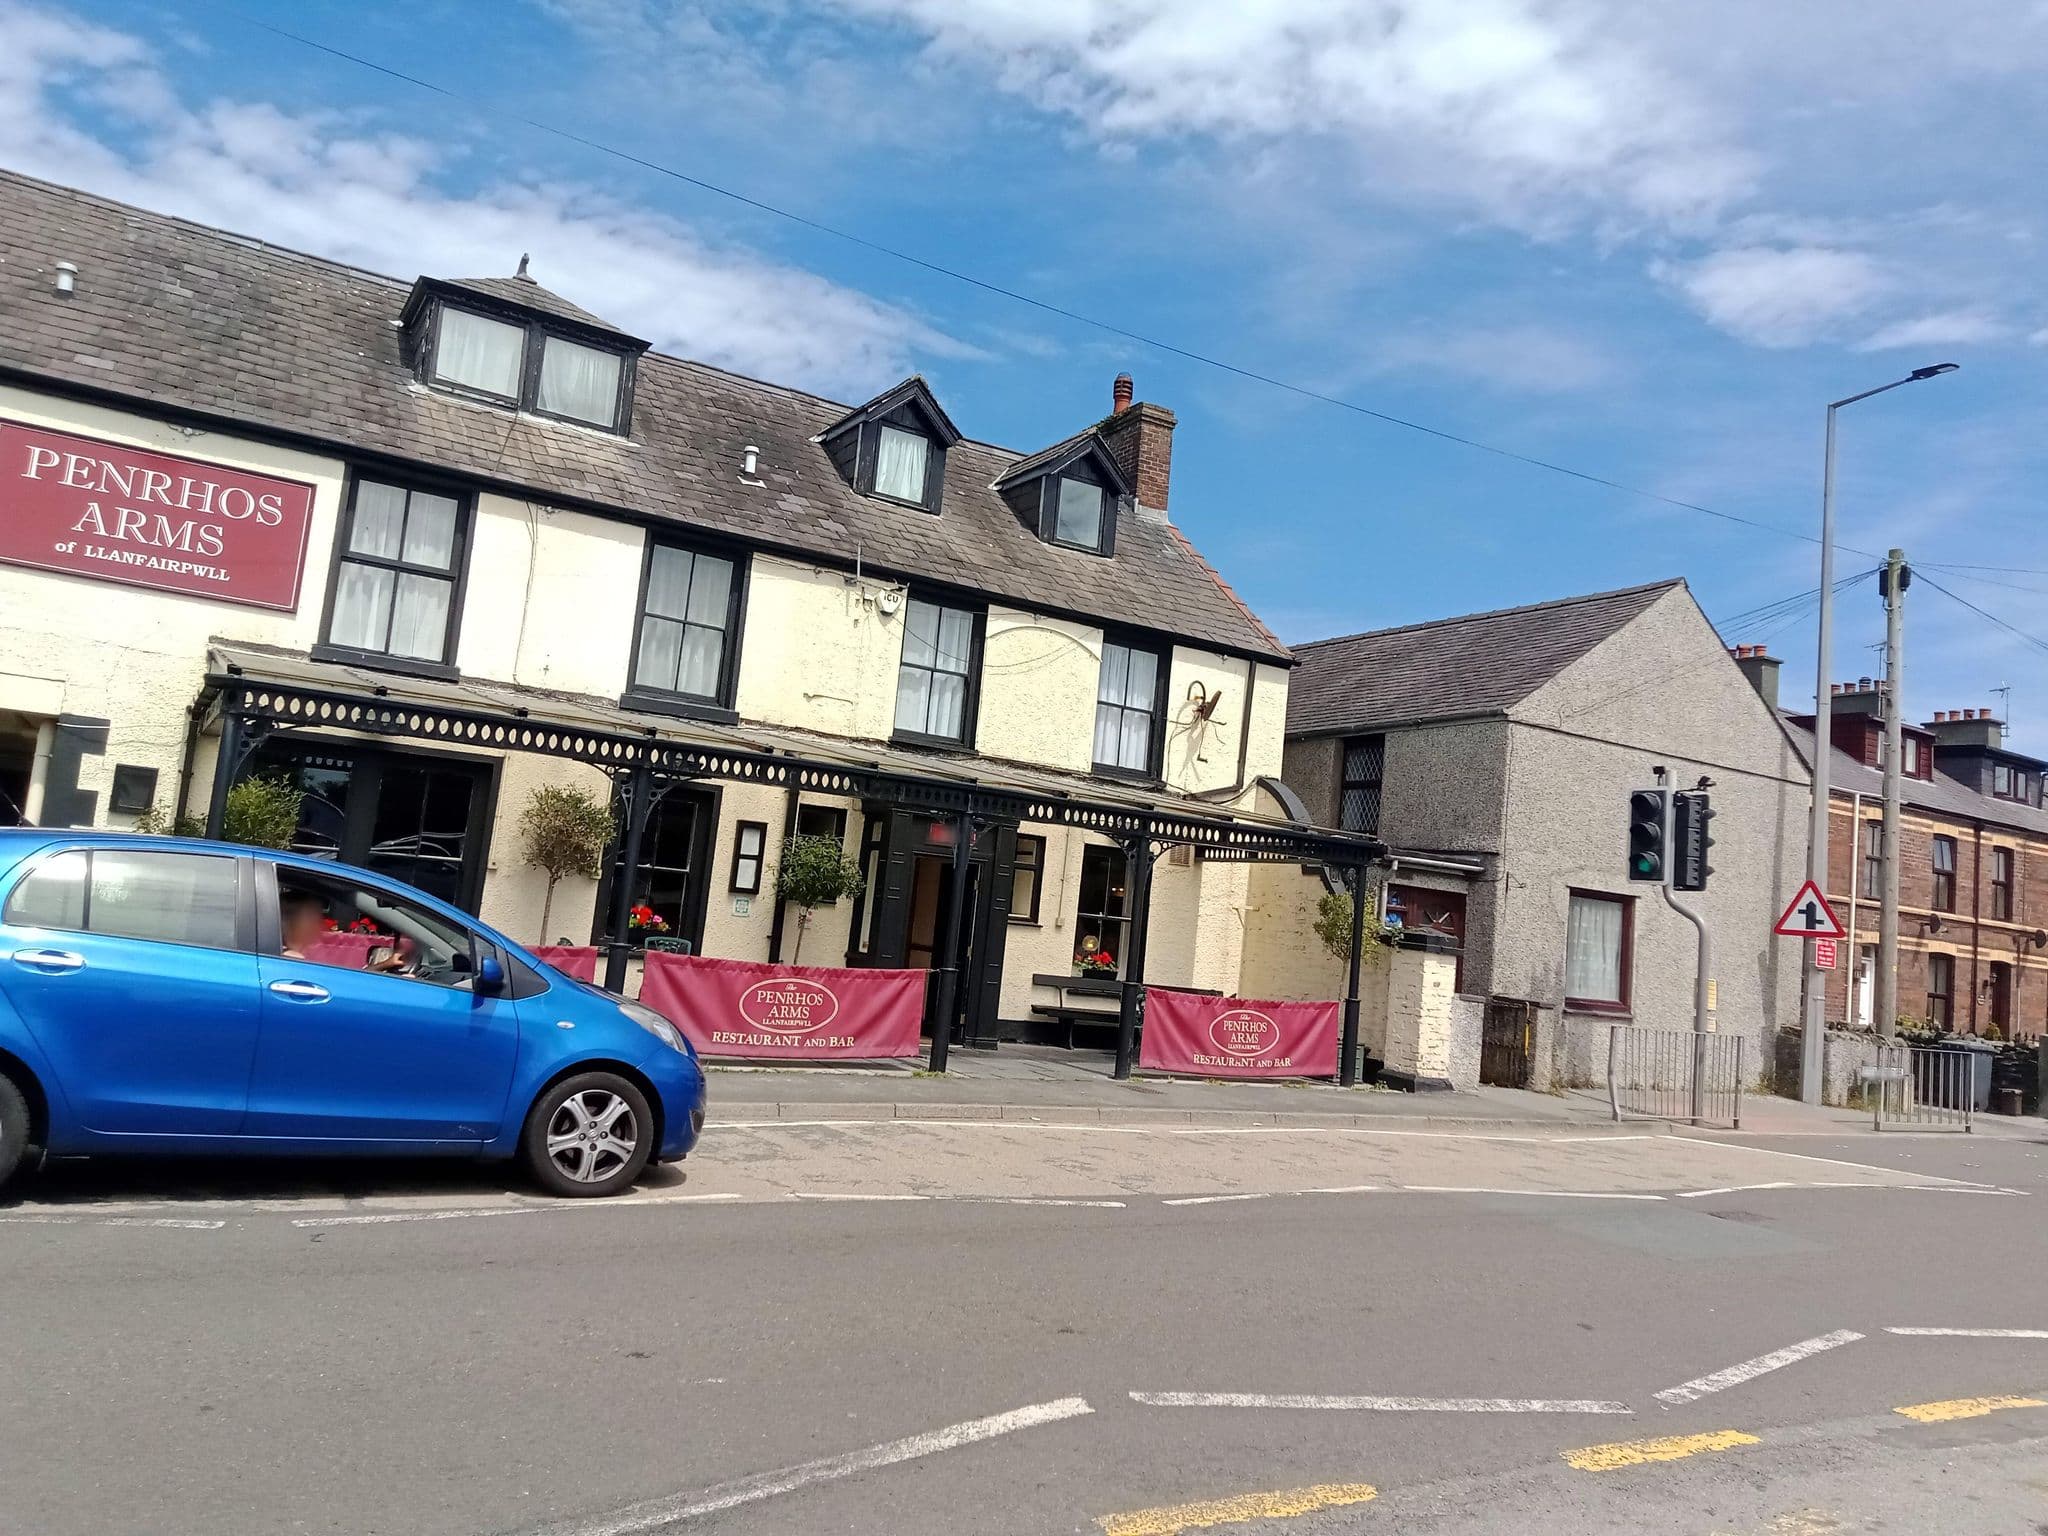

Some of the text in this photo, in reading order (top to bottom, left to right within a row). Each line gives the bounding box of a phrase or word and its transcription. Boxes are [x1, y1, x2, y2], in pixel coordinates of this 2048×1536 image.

[21, 445, 283, 526] PENRHOS
[71, 502, 225, 557] ARMS
[54, 541, 230, 581] of LLANFAIRPWLL
[756, 990, 824, 1006] PENRHOS
[767, 1005, 810, 1019] ARMS
[1223, 1020, 1268, 1033] PENRHOS
[712, 1031, 855, 1048] RESTAURANT AND BAR
[1231, 1032, 1259, 1043] ARMS
[1193, 1054, 1255, 1068] RESTAURANT
[1274, 1058, 1291, 1067] BAR
